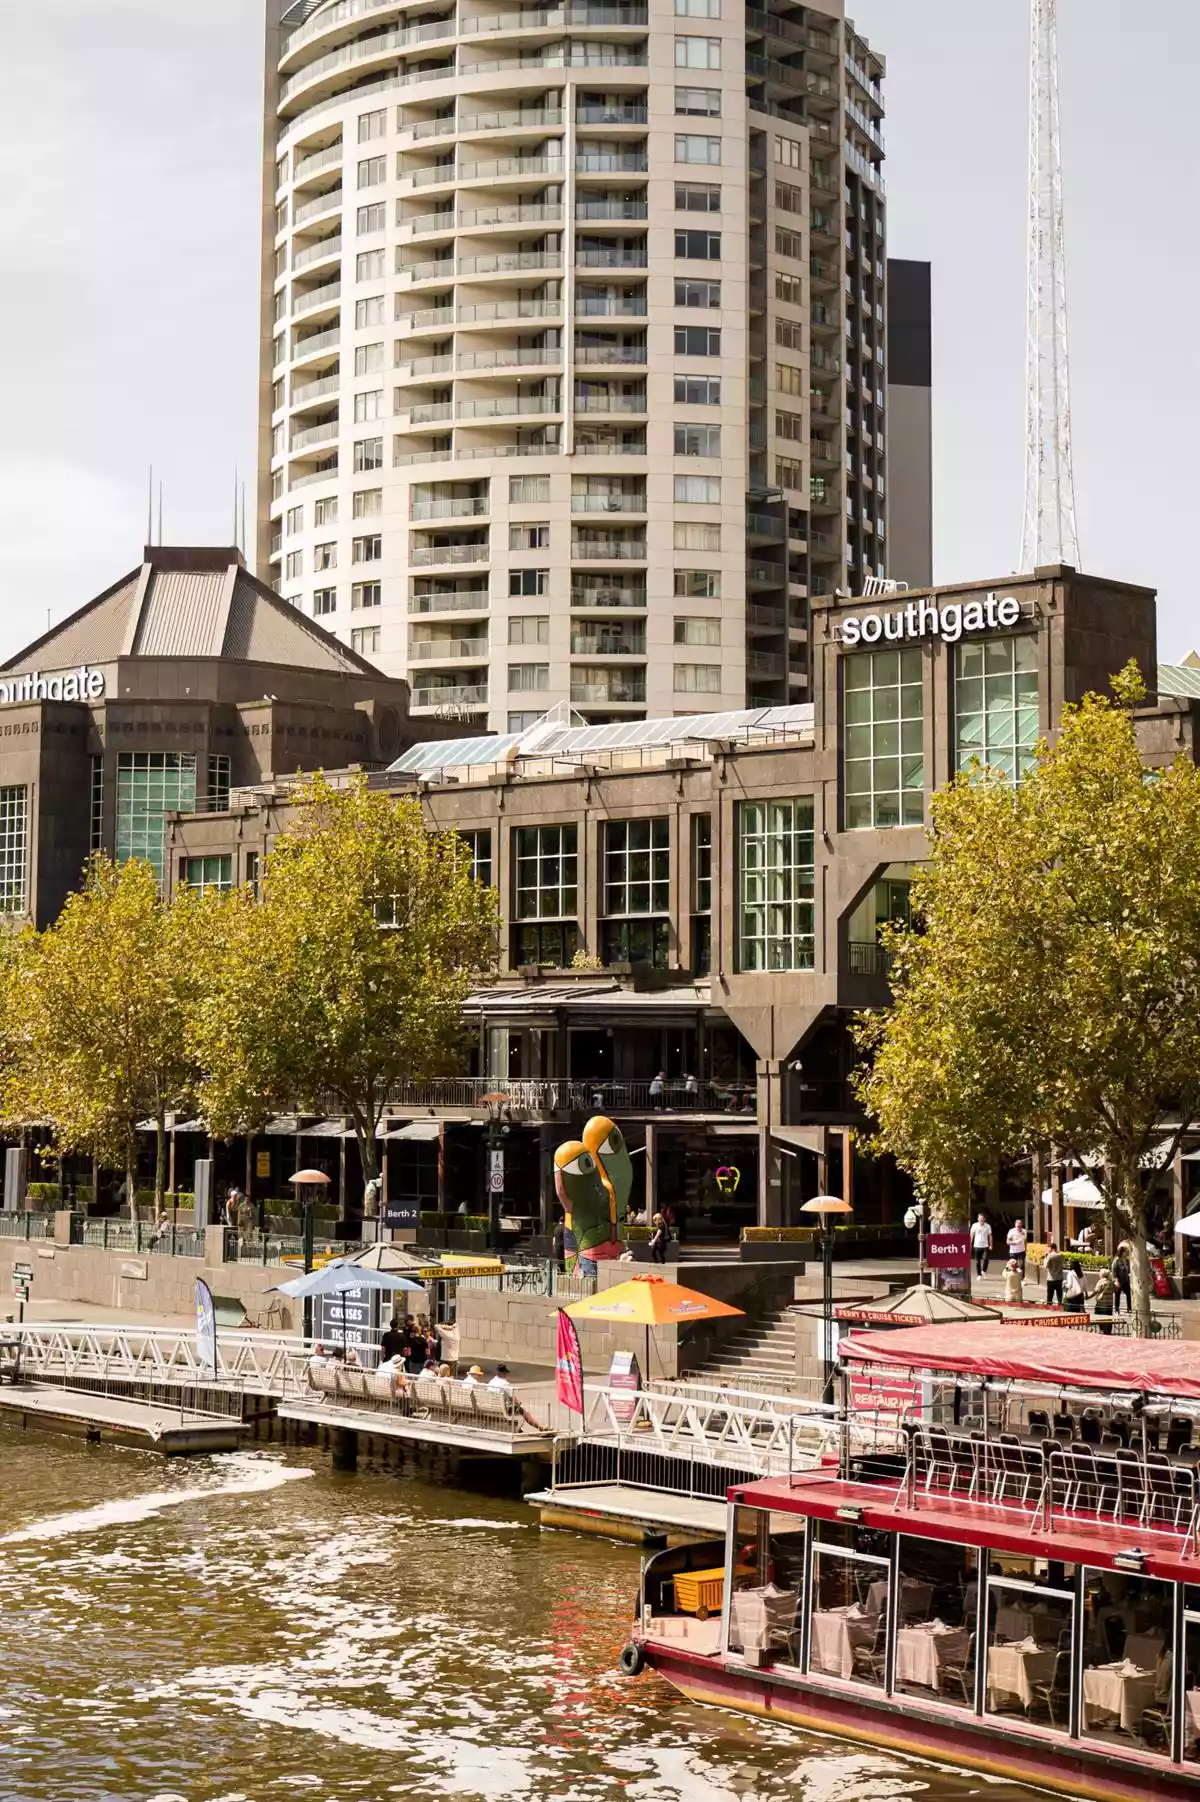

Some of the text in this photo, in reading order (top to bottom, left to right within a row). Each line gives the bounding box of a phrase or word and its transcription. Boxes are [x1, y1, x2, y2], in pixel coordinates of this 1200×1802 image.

[842, 592, 1019, 644] southgate
[494, 1177, 501, 1185] 10
[387, 1209, 417, 1218] Berth 2
[931, 1244, 966, 1254] Berth 1
[453, 1267, 475, 1275] CRUISE
[477, 1266, 502, 1274] TICKETS
[330, 1307, 362, 1320] CRUISES
[839, 1309, 923, 1324] FERRY & CRUISE TICKETS
[1034, 1317, 1059, 1326] CRUISE
[1060, 1315, 1087, 1325] TICKETS
[330, 1328, 362, 1342] TICKETS
